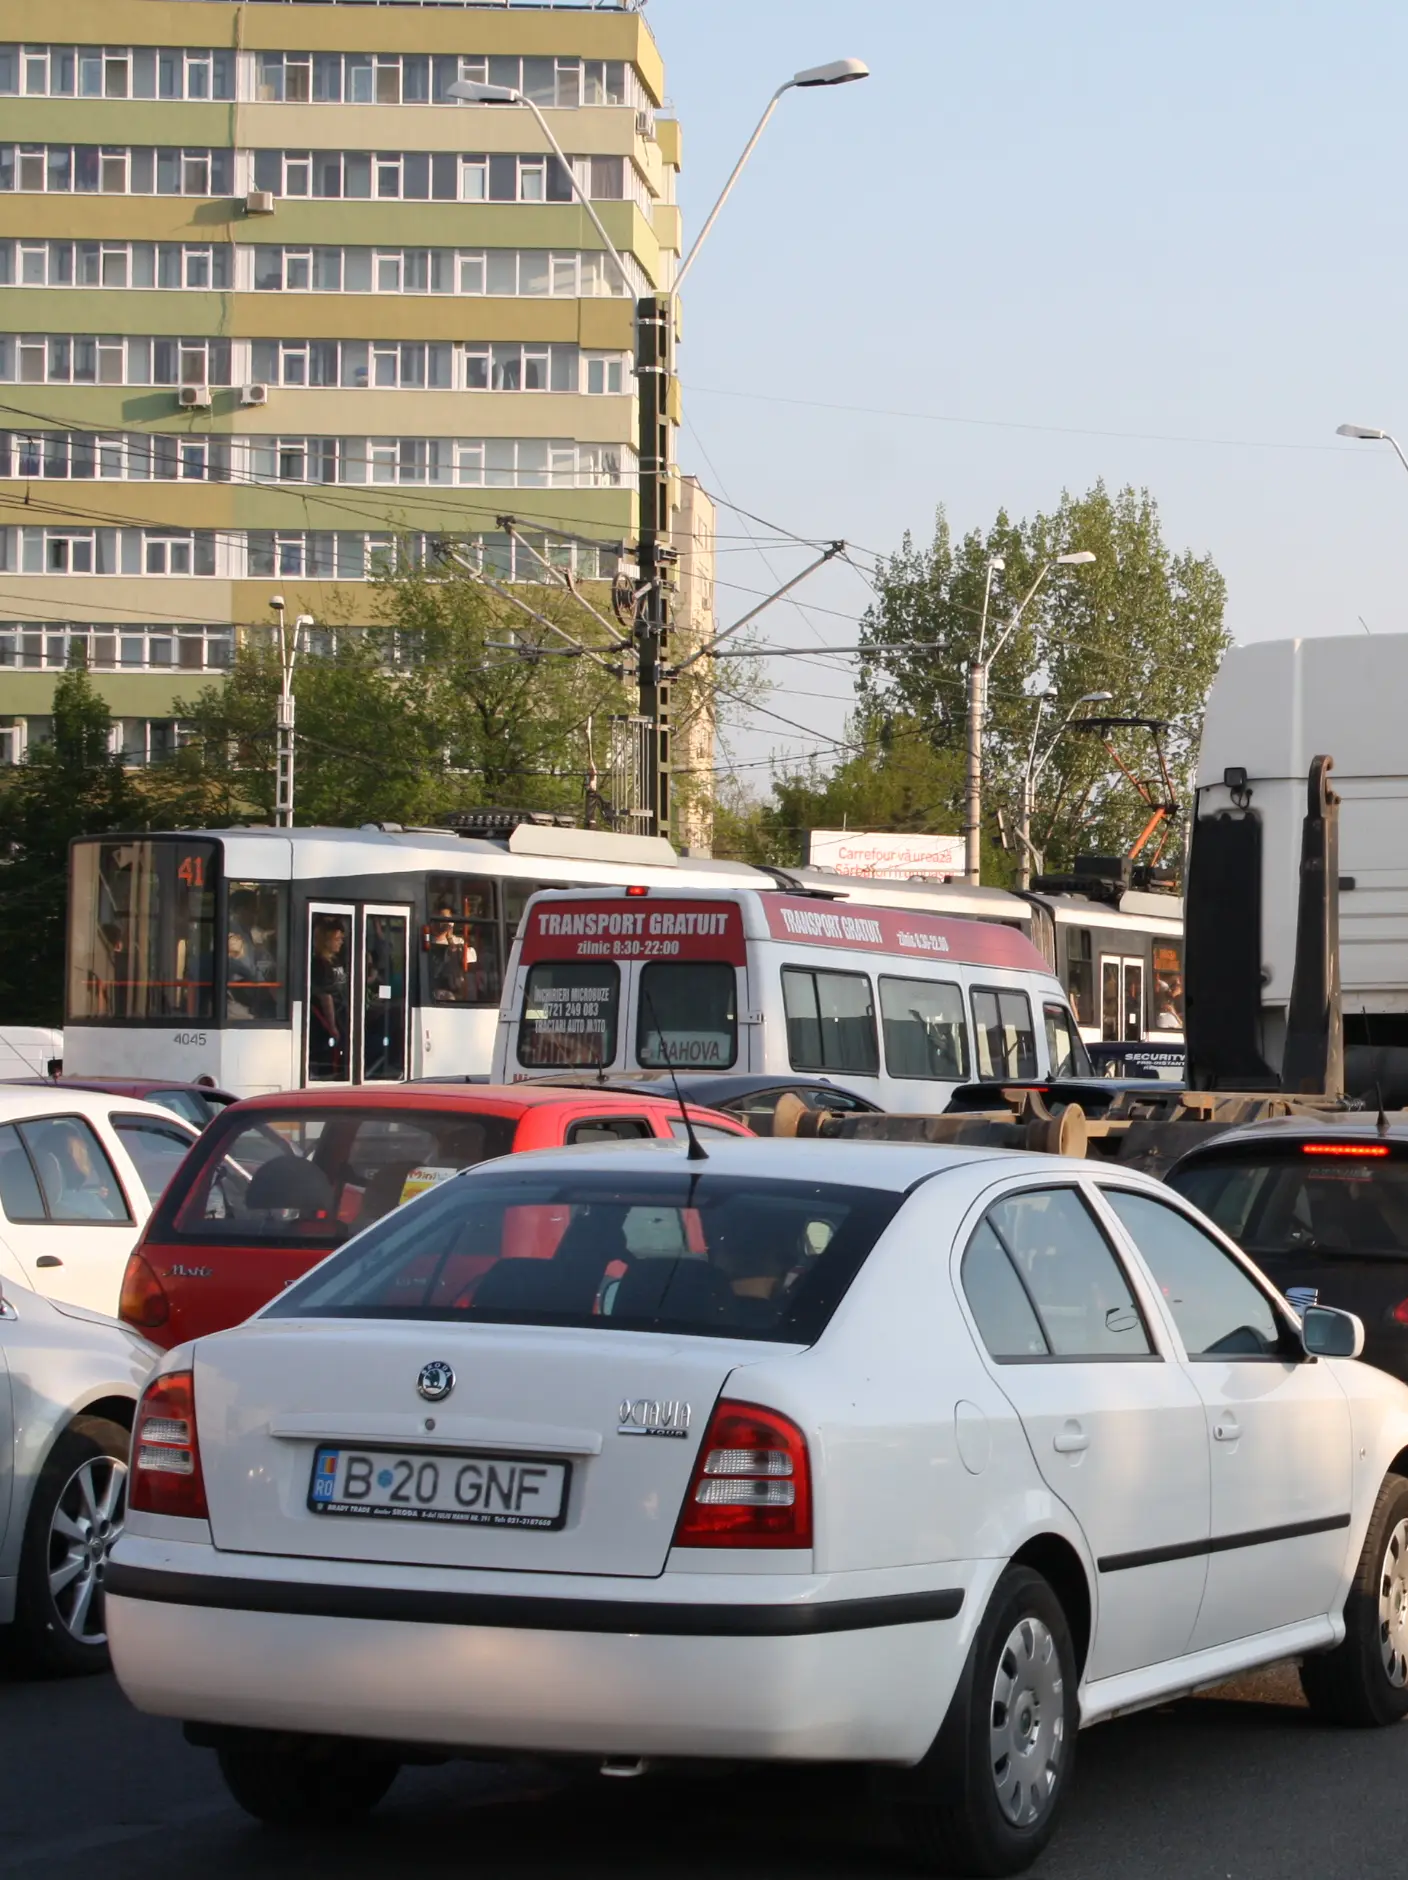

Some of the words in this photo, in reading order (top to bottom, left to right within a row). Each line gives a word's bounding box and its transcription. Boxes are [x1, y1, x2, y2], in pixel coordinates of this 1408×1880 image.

[838, 846, 894, 862] Carrefour
[178, 856, 204, 887] 41
[538, 914, 645, 936] TRANSPORT
[649, 913, 728, 935] GRATUIT
[780, 908, 843, 939] TRANSPORT
[840, 916, 884, 944] GRATUIT
[577, 941, 610, 954] zilnic
[613, 941, 680, 955] 8:30-22:00
[173, 1033, 207, 1046] 4045
[657, 1041, 720, 1061] RAHOVA
[1124, 1053, 1186, 1061] SECURITY
[619, 1399, 691, 1427] OCTAVIA
[649, 1429, 684, 1437] TOUR
[316, 1479, 332, 1497] RO
[343, 1456, 374, 1500] B
[389, 1460, 440, 1505] 20
[454, 1463, 547, 1511] GNF
